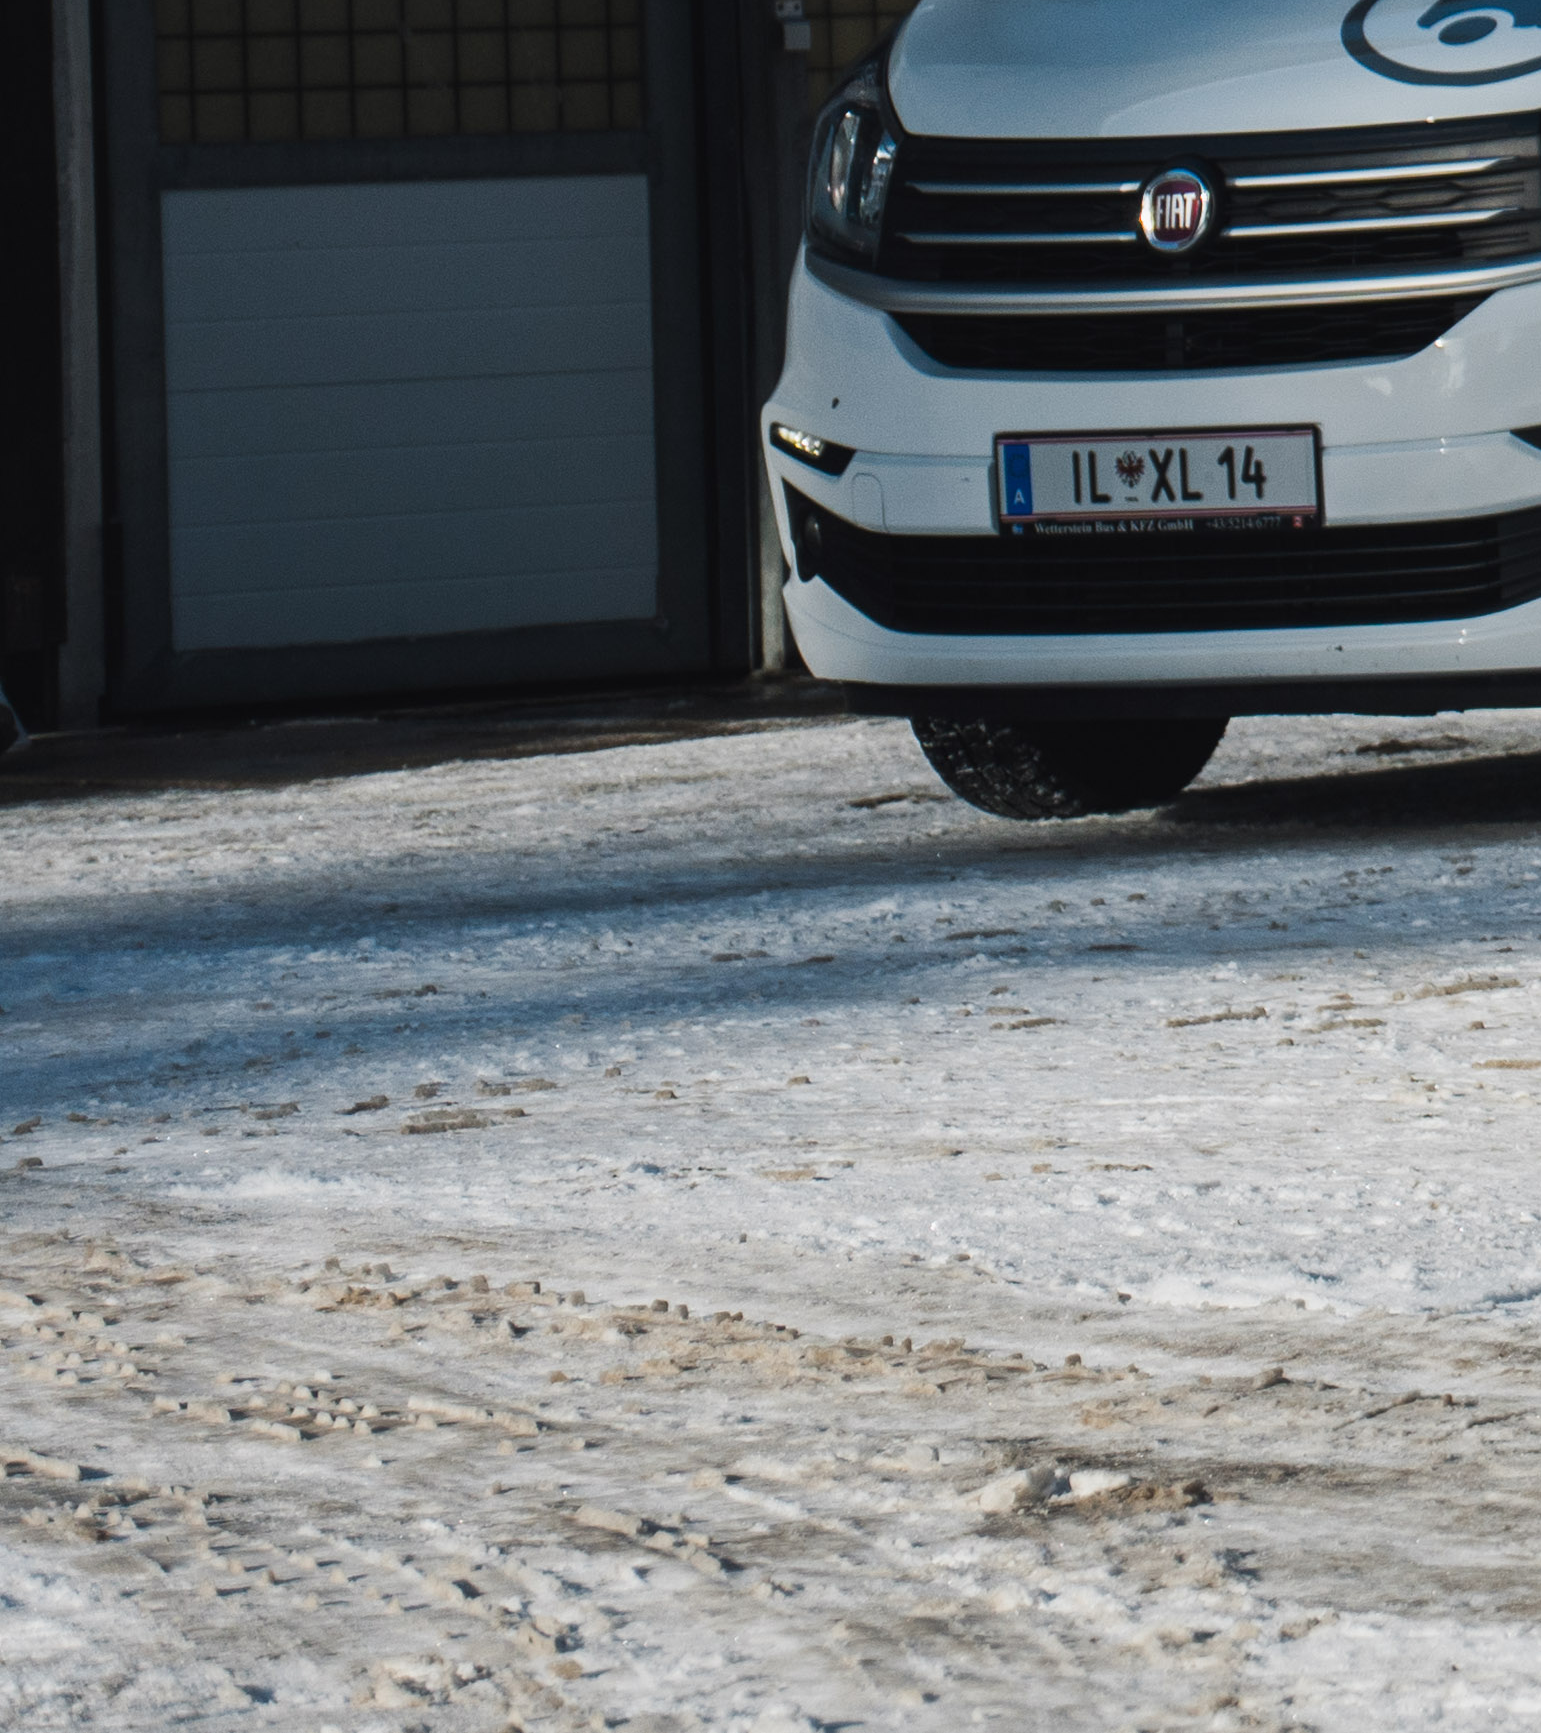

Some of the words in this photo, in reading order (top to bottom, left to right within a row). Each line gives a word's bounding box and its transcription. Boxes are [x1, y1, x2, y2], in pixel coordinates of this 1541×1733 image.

[1155, 191, 1197, 230] FIAT
[1072, 450, 1112, 504] IL
[1149, 447, 1204, 502] XL
[1217, 445, 1267, 500] 14
[1013, 489, 1026, 505] A
[1033, 521, 1093, 535] Wetterstein
